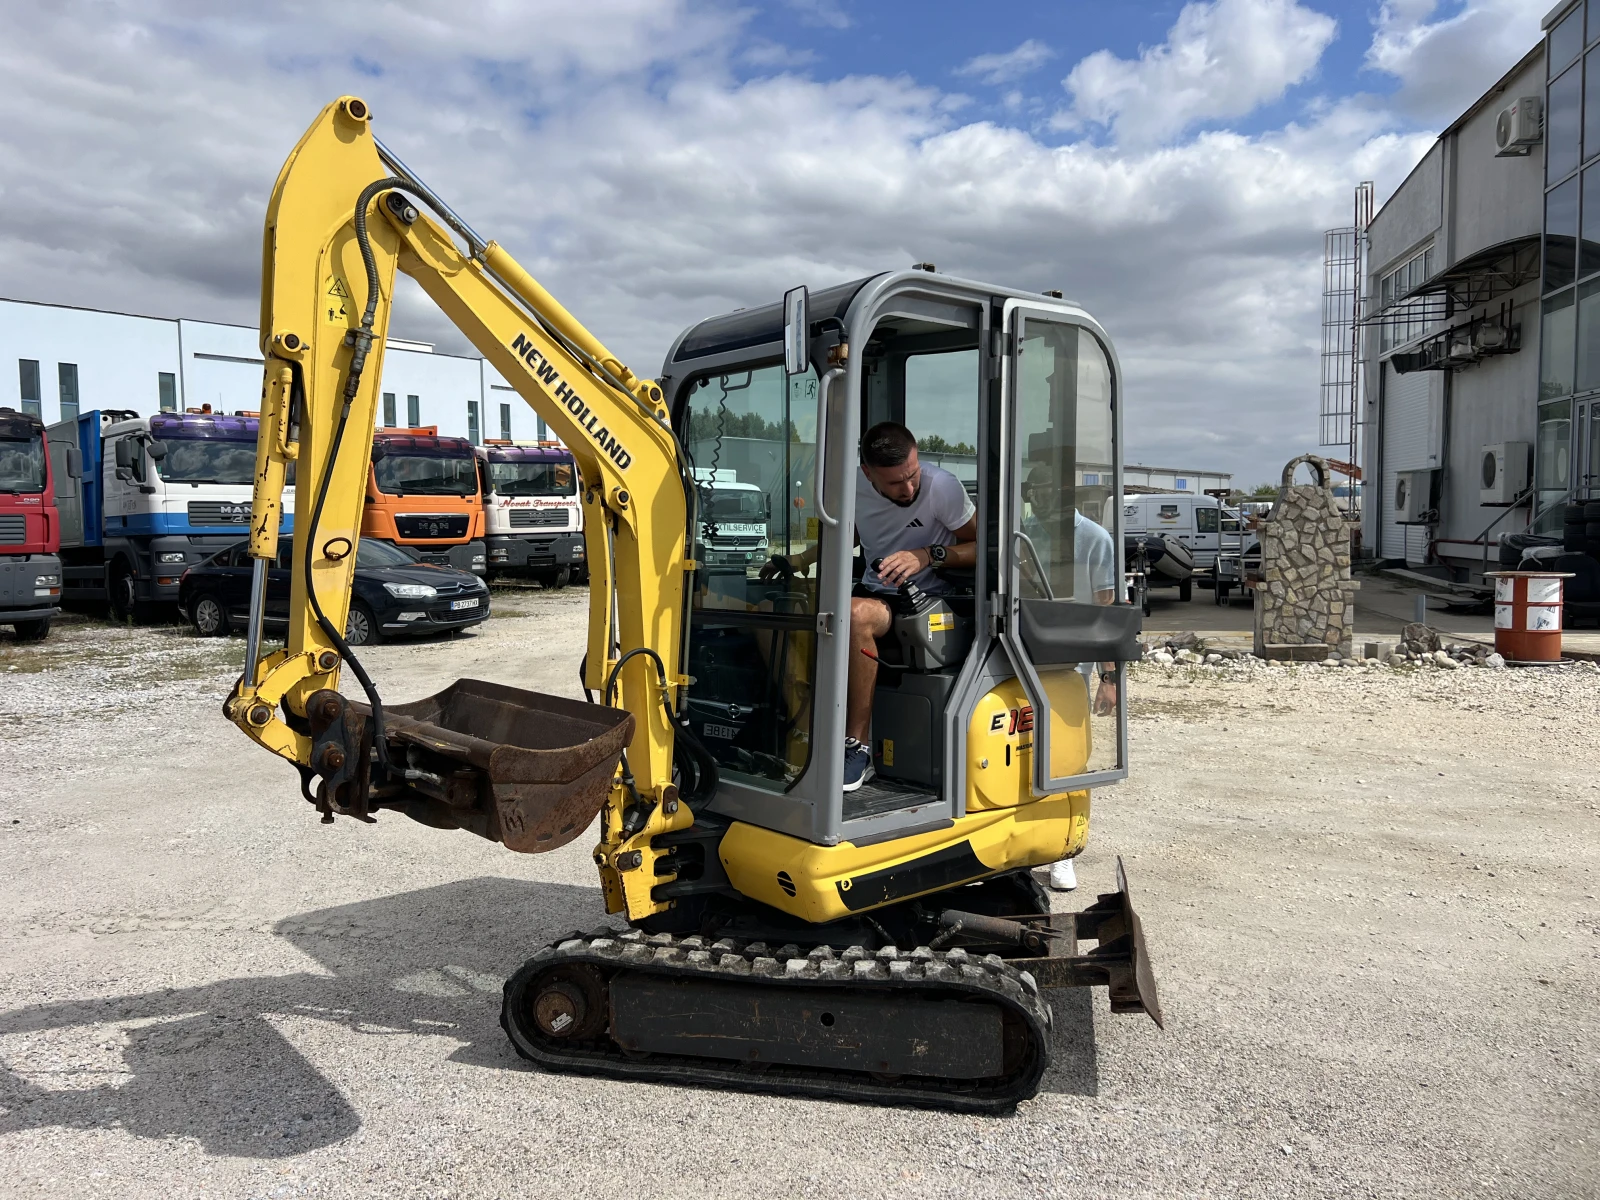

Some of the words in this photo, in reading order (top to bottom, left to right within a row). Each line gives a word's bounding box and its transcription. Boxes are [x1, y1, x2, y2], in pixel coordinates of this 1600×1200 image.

[511, 333, 559, 385] NEW
[554, 381, 631, 470] HOLLAND
[500, 499, 531, 508] Novak
[220, 506, 253, 514] MAN
[418, 522, 450, 530] MAN
[714, 524, 763, 532] XTILSERVICE
